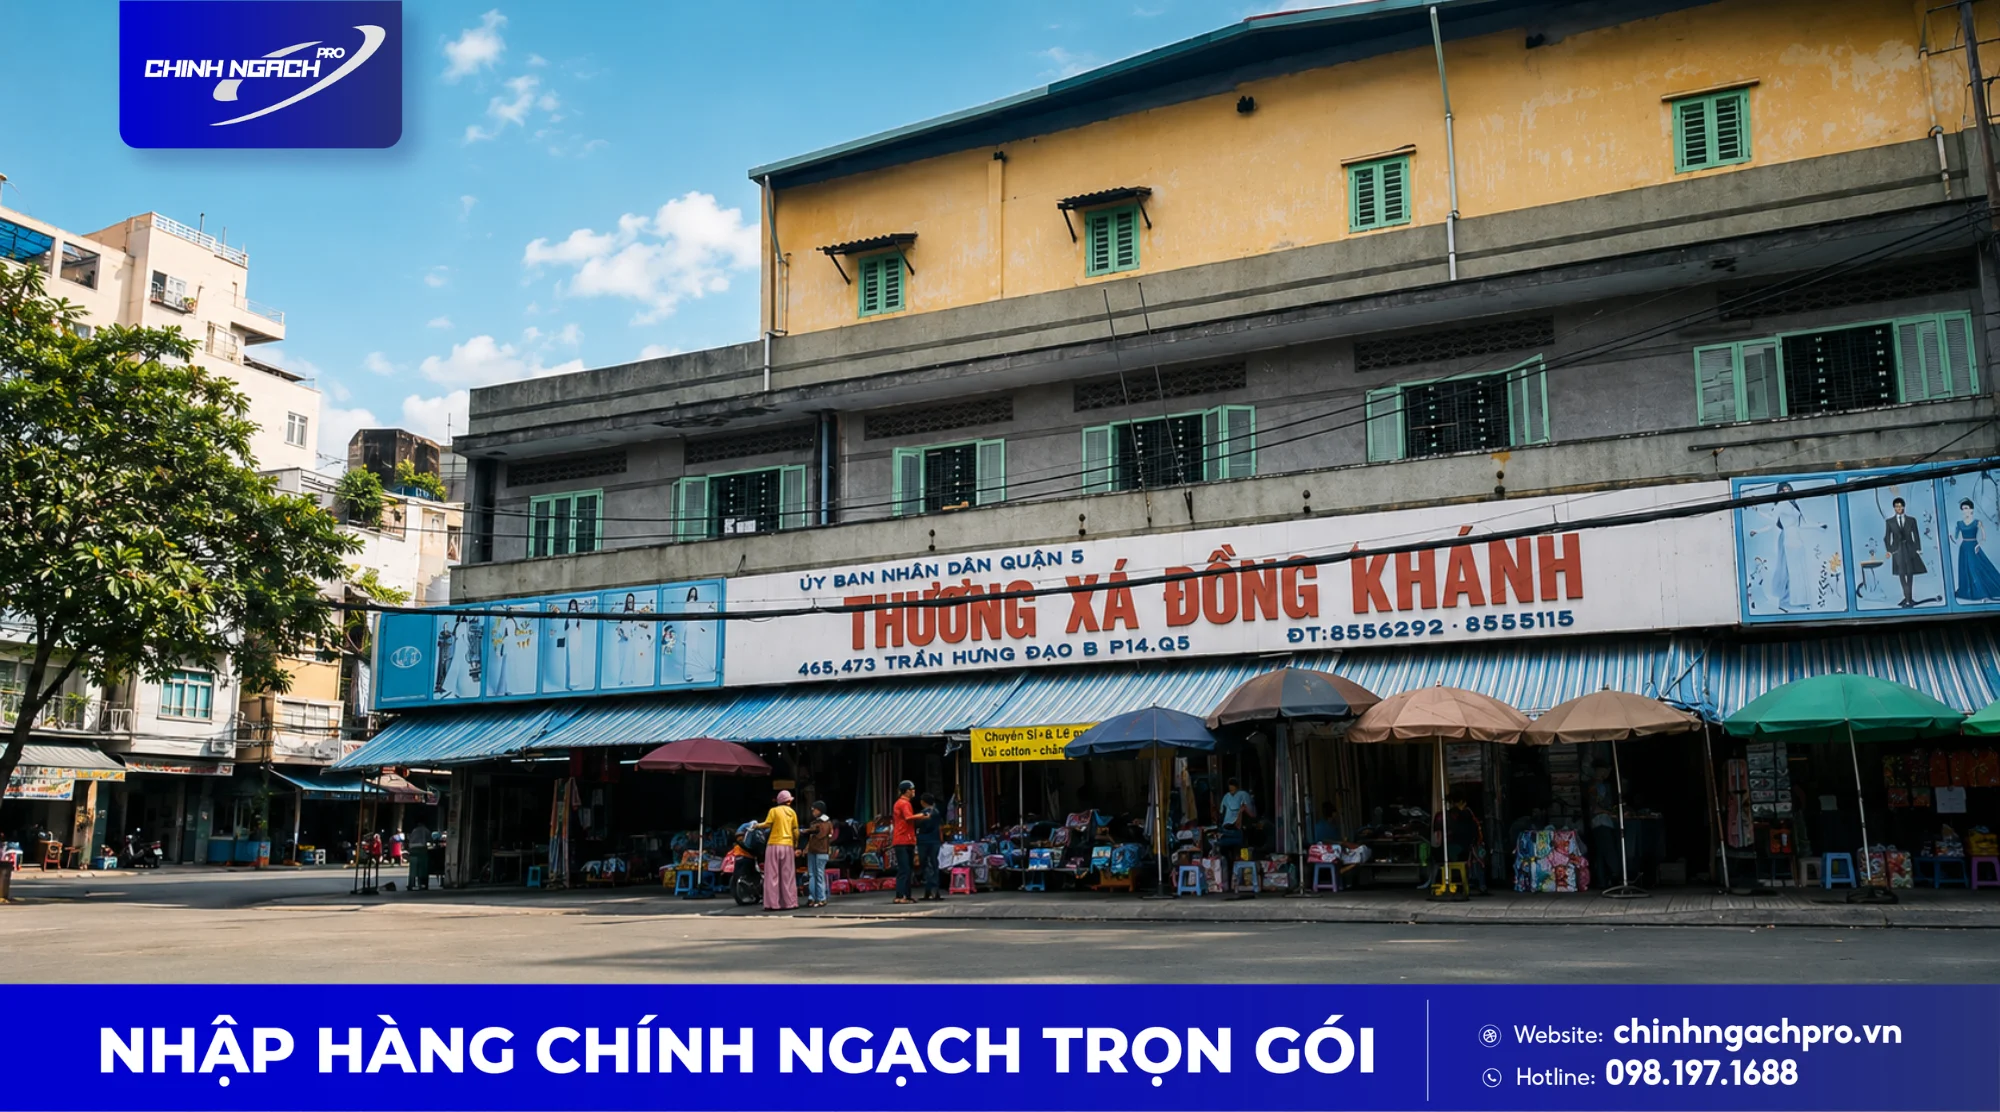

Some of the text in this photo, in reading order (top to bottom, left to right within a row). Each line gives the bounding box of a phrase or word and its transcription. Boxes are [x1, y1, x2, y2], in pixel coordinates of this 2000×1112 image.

[833, 571, 875, 588] BAN
[881, 562, 940, 583] NHÂN
[947, 555, 992, 576] DÂN
[1000, 549, 1064, 572] QUẬN
[1071, 549, 1084, 564] 5
[843, 525, 1584, 651] THƯƠNG XÁ ĐỒNG KHÁNH
[1287, 620, 1444, 644] ĐT:8556292
[1465, 611, 1575, 632] 8555115
[798, 656, 877, 677] 465,473
[952, 646, 1016, 664] HƯNG
[1025, 642, 1073, 661] ĐẠO
[1082, 641, 1098, 656] B
[1109, 635, 1191, 655] P14.Q5
[999, 745, 1031, 757] cotton
